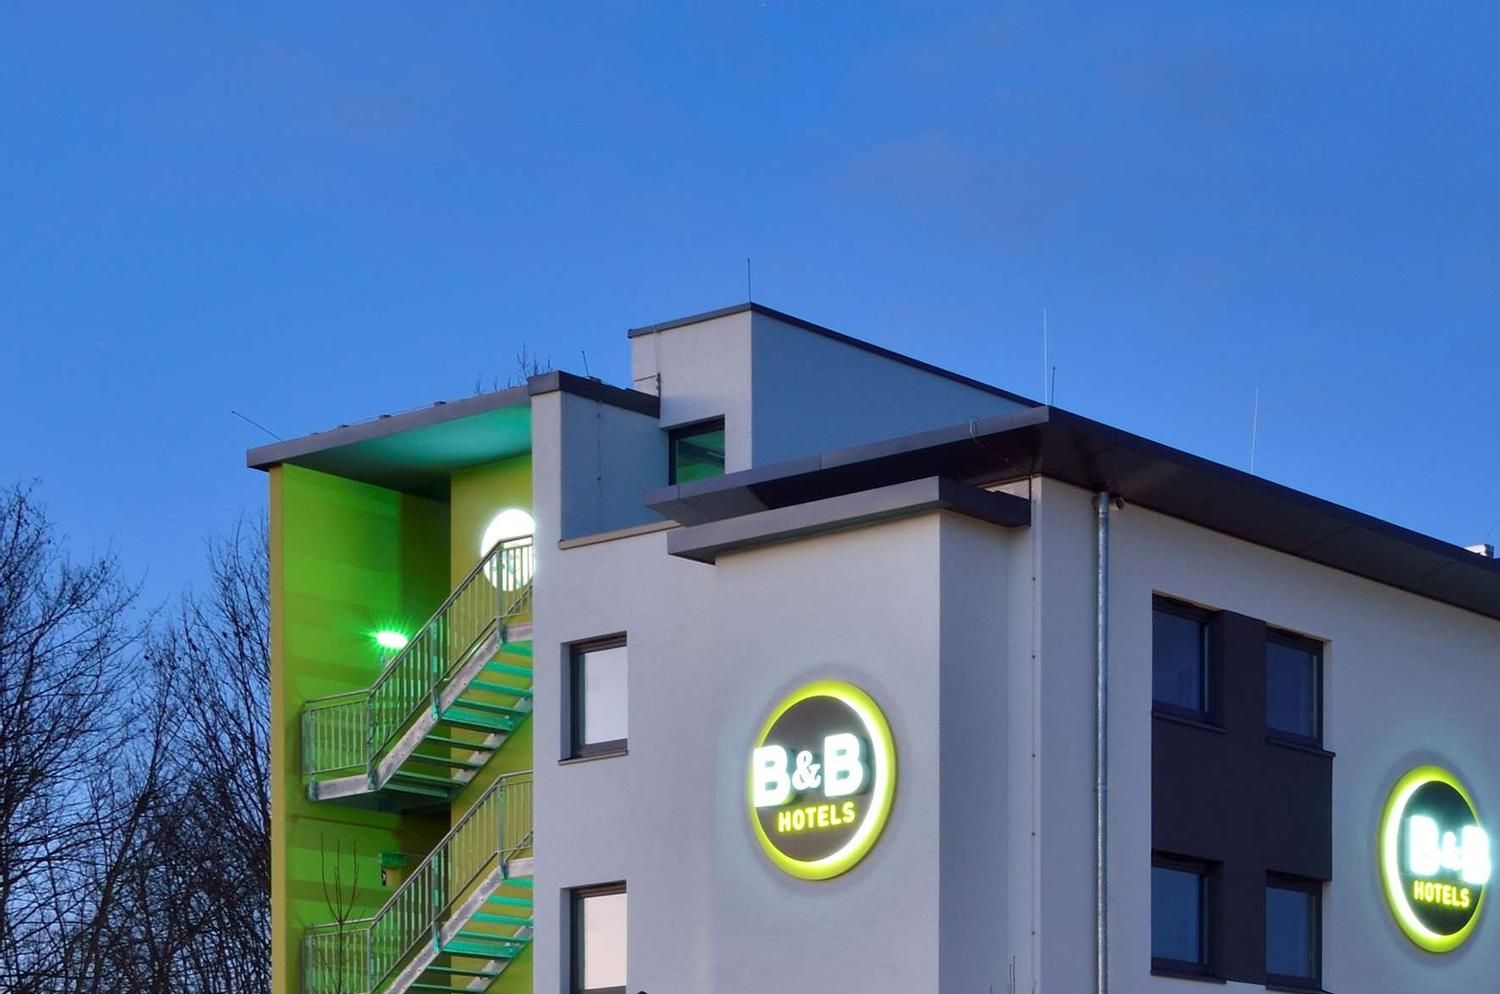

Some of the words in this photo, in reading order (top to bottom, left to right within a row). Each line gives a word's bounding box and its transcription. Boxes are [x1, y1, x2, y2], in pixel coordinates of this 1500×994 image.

[752, 733, 868, 808] B&B
[777, 801, 857, 833] HOTELS
[1412, 880, 1471, 908] HOTELS
